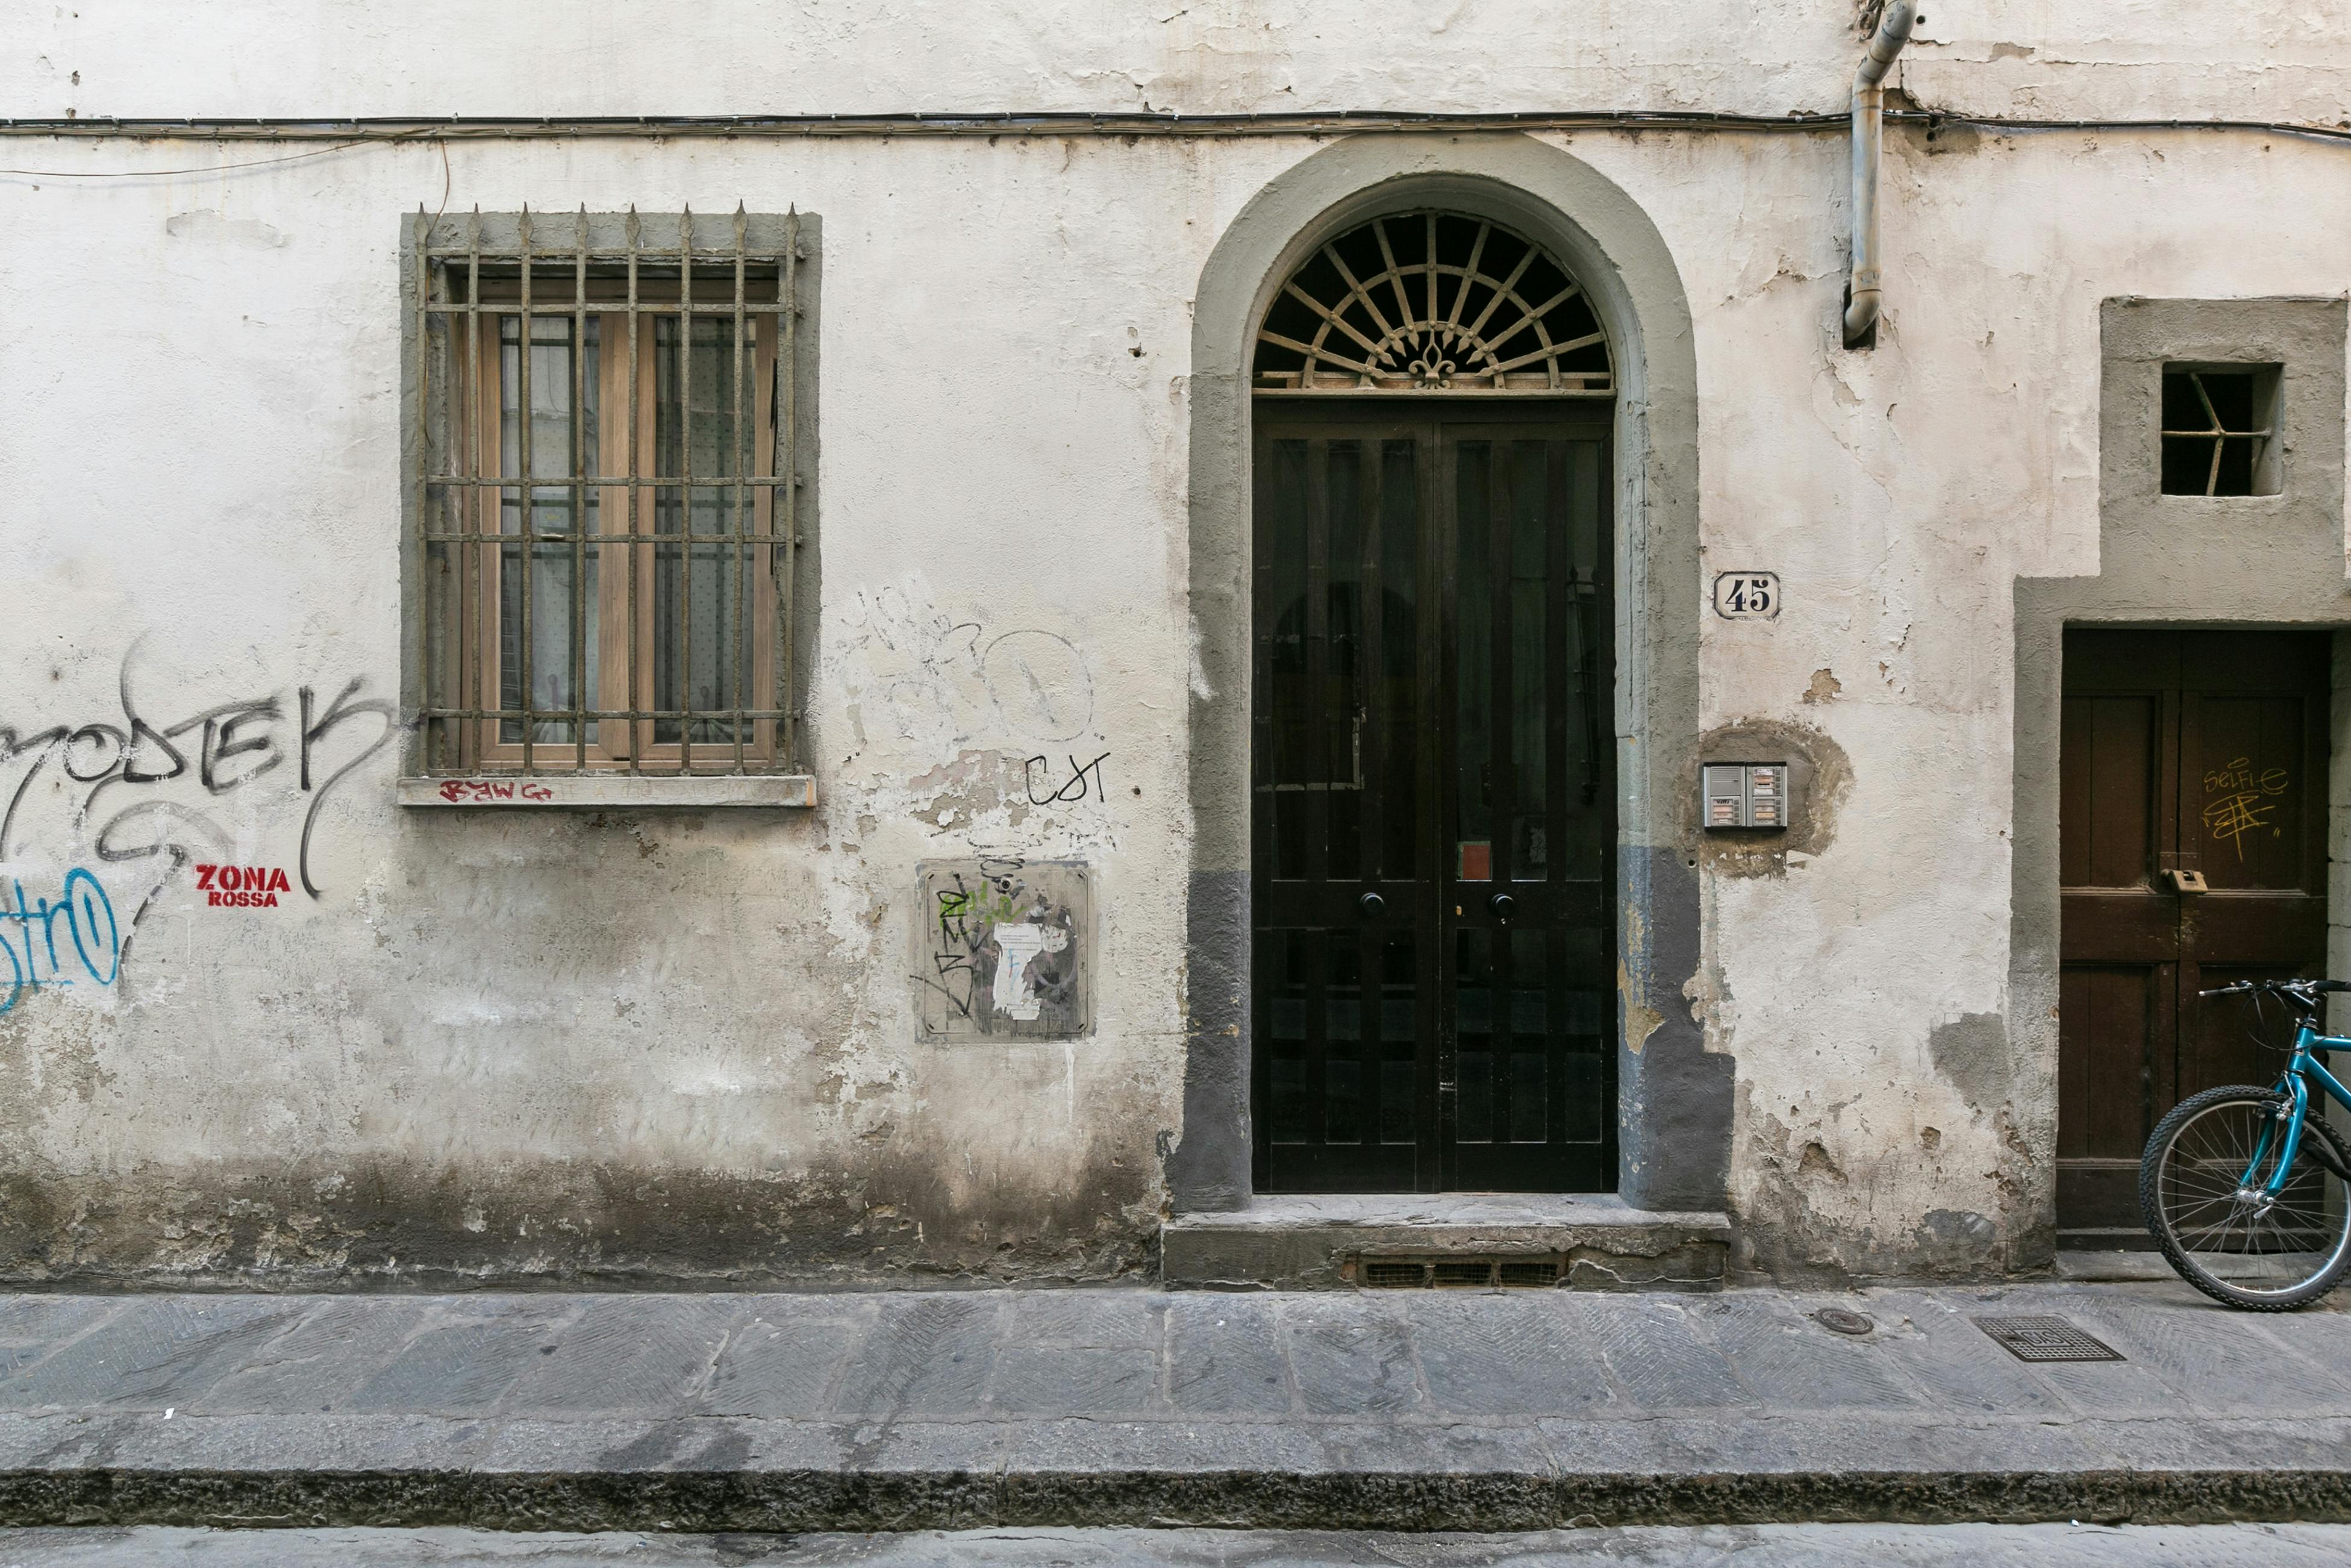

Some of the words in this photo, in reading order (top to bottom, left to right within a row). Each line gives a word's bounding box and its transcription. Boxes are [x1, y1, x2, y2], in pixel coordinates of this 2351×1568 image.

[1725, 579, 1770, 611] 45
[194, 864, 291, 892] ZONA
[208, 891, 278, 907] ROSSA
